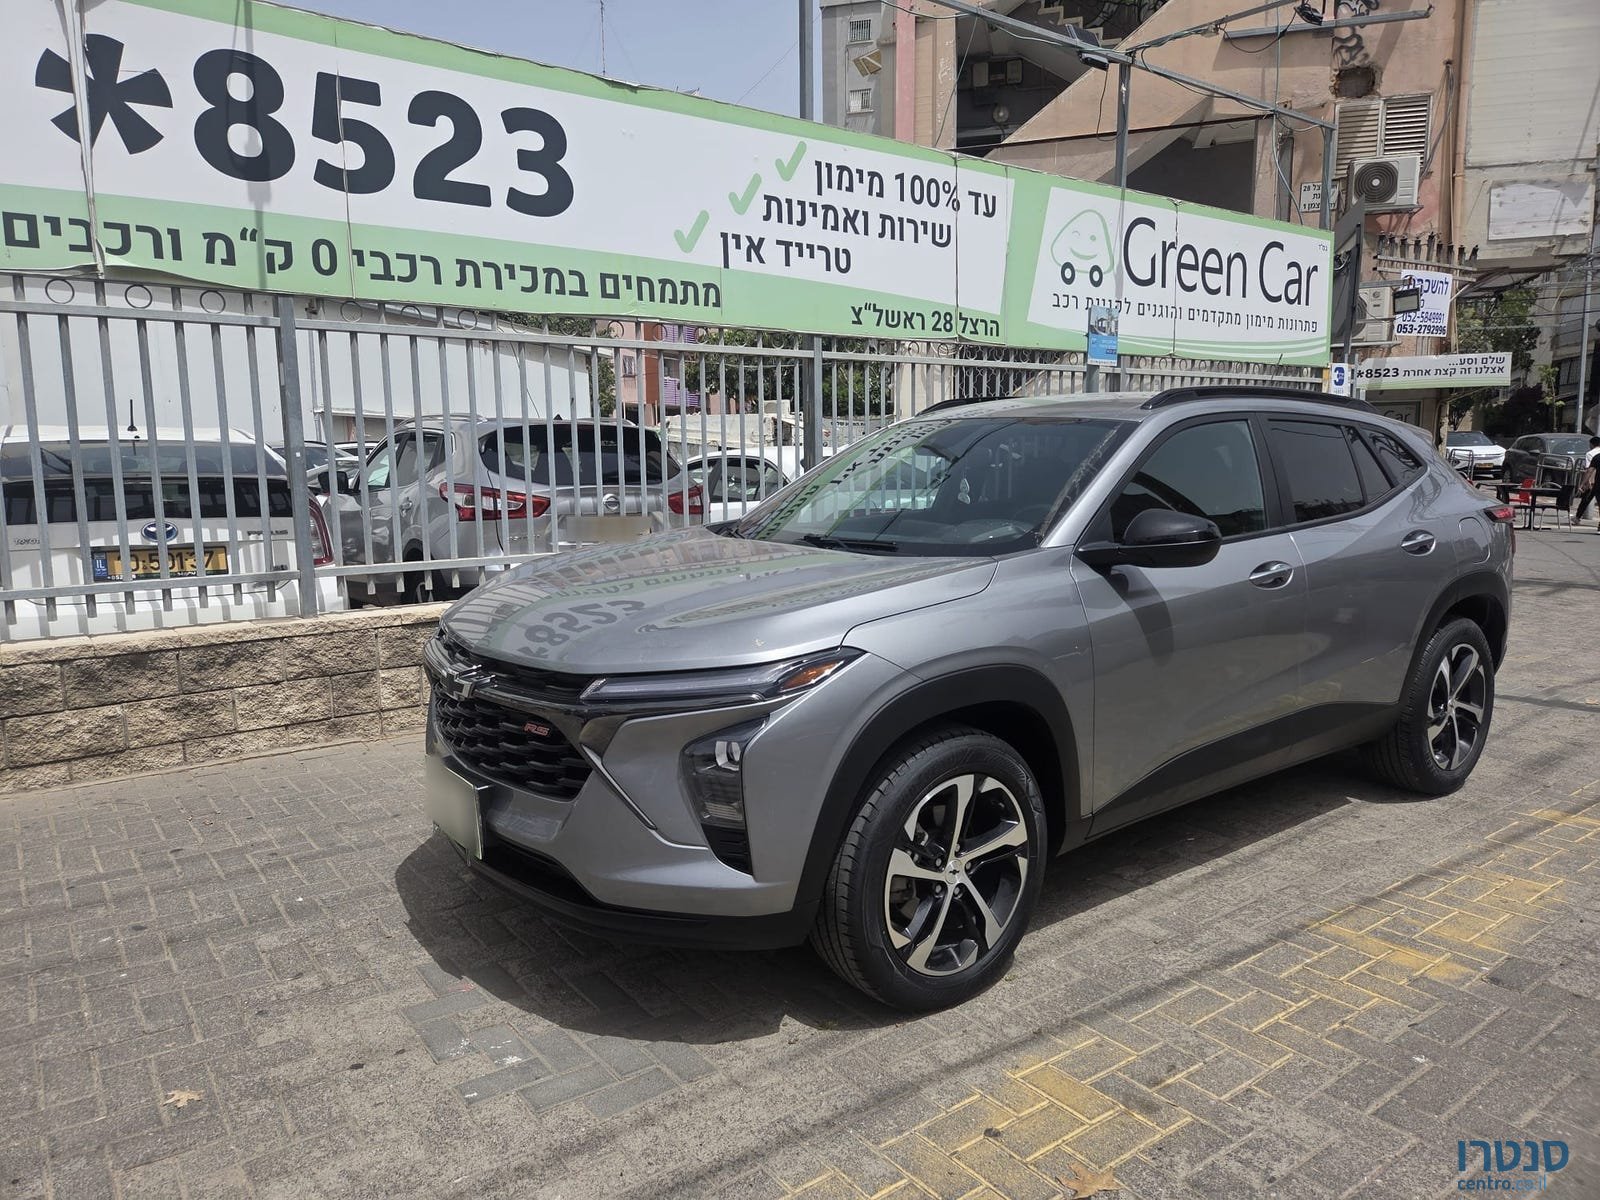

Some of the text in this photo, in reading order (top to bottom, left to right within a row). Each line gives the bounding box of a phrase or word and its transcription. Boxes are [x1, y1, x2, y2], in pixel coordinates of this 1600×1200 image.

[814, 160, 997, 218] עד 100% מימון
[762, 194, 952, 248] שירות ואמינות
[2, 211, 182, 262] ורכבים
[311, 238, 338, 276] 0
[720, 231, 852, 274] טרייד אין
[1123, 216, 1319, 307] Green Car
[351, 248, 442, 285] רכבי
[455, 258, 590, 298] במכירת
[600, 271, 721, 308] מתמחים
[1052, 293, 1079, 309] רכב
[1137, 303, 1182, 320] והוגנים
[1188, 308, 1241, 327] מתקדמים
[931, 310, 954, 333] 28
[958, 312, 1000, 337] הרצל
[1246, 314, 1273, 330] מימון
[1278, 317, 1317, 332] פתרונות
[1481, 355, 1505, 365] שלם
[1403, 368, 1431, 377] אחרת
[1434, 367, 1457, 377] קצת
[1460, 367, 1472, 375] זה
[1475, 365, 1505, 375] אצלנו
[96, 559, 105, 569] IL
[524, 723, 550, 736] RS
